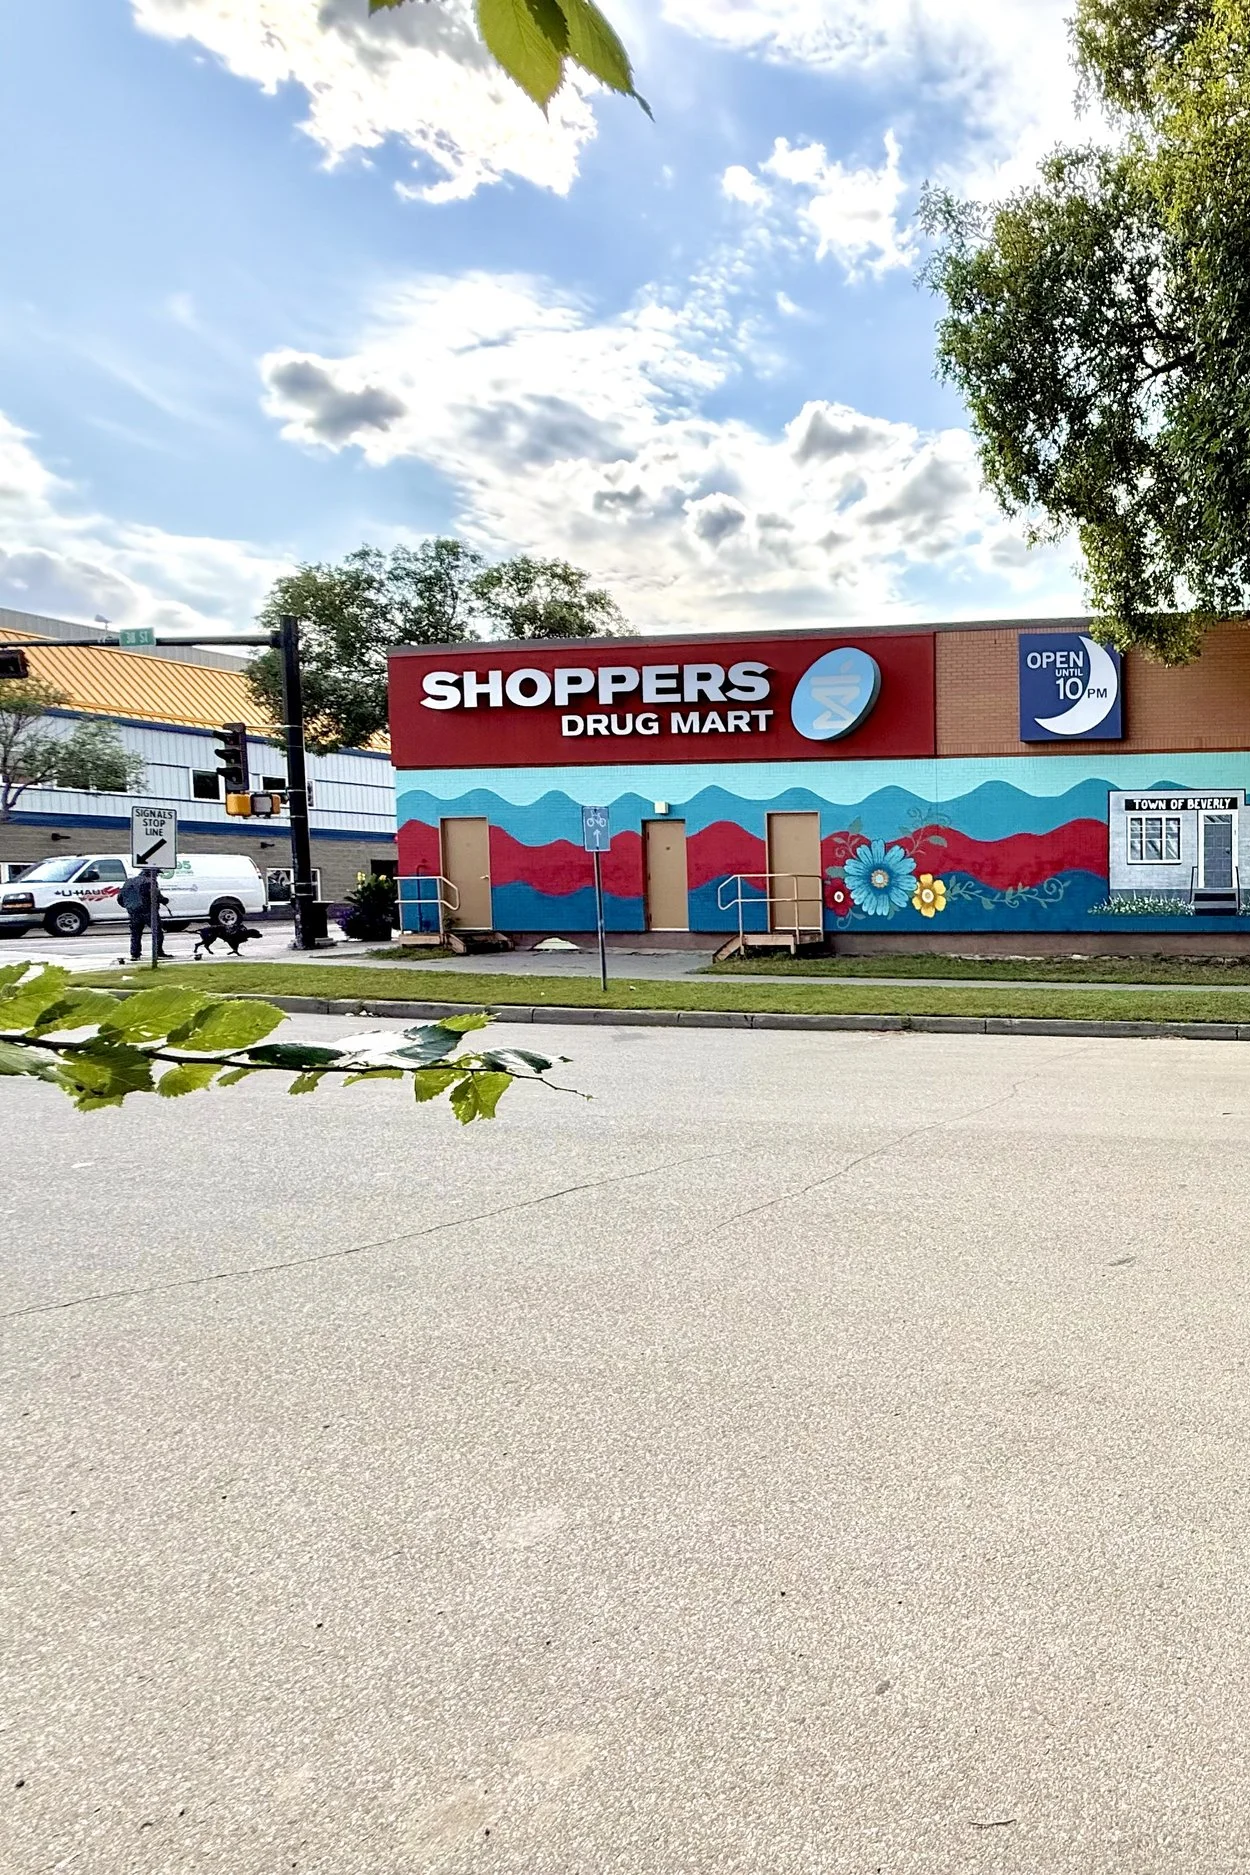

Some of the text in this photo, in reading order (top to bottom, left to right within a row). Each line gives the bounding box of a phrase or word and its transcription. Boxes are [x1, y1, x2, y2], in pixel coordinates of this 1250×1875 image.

[1026, 651, 1084, 669] OPEN
[1055, 668, 1084, 677] UNTIL
[420, 662, 772, 710] SHOPPERS
[1055, 677, 1108, 700] 10 PM
[561, 709, 774, 737] DRUG MART
[1133, 798, 1231, 810] TOWN OF BEVERLY
[135, 808, 173, 820] SIGNALS
[142, 818, 166, 828] STOP
[145, 827, 164, 837] LINE
